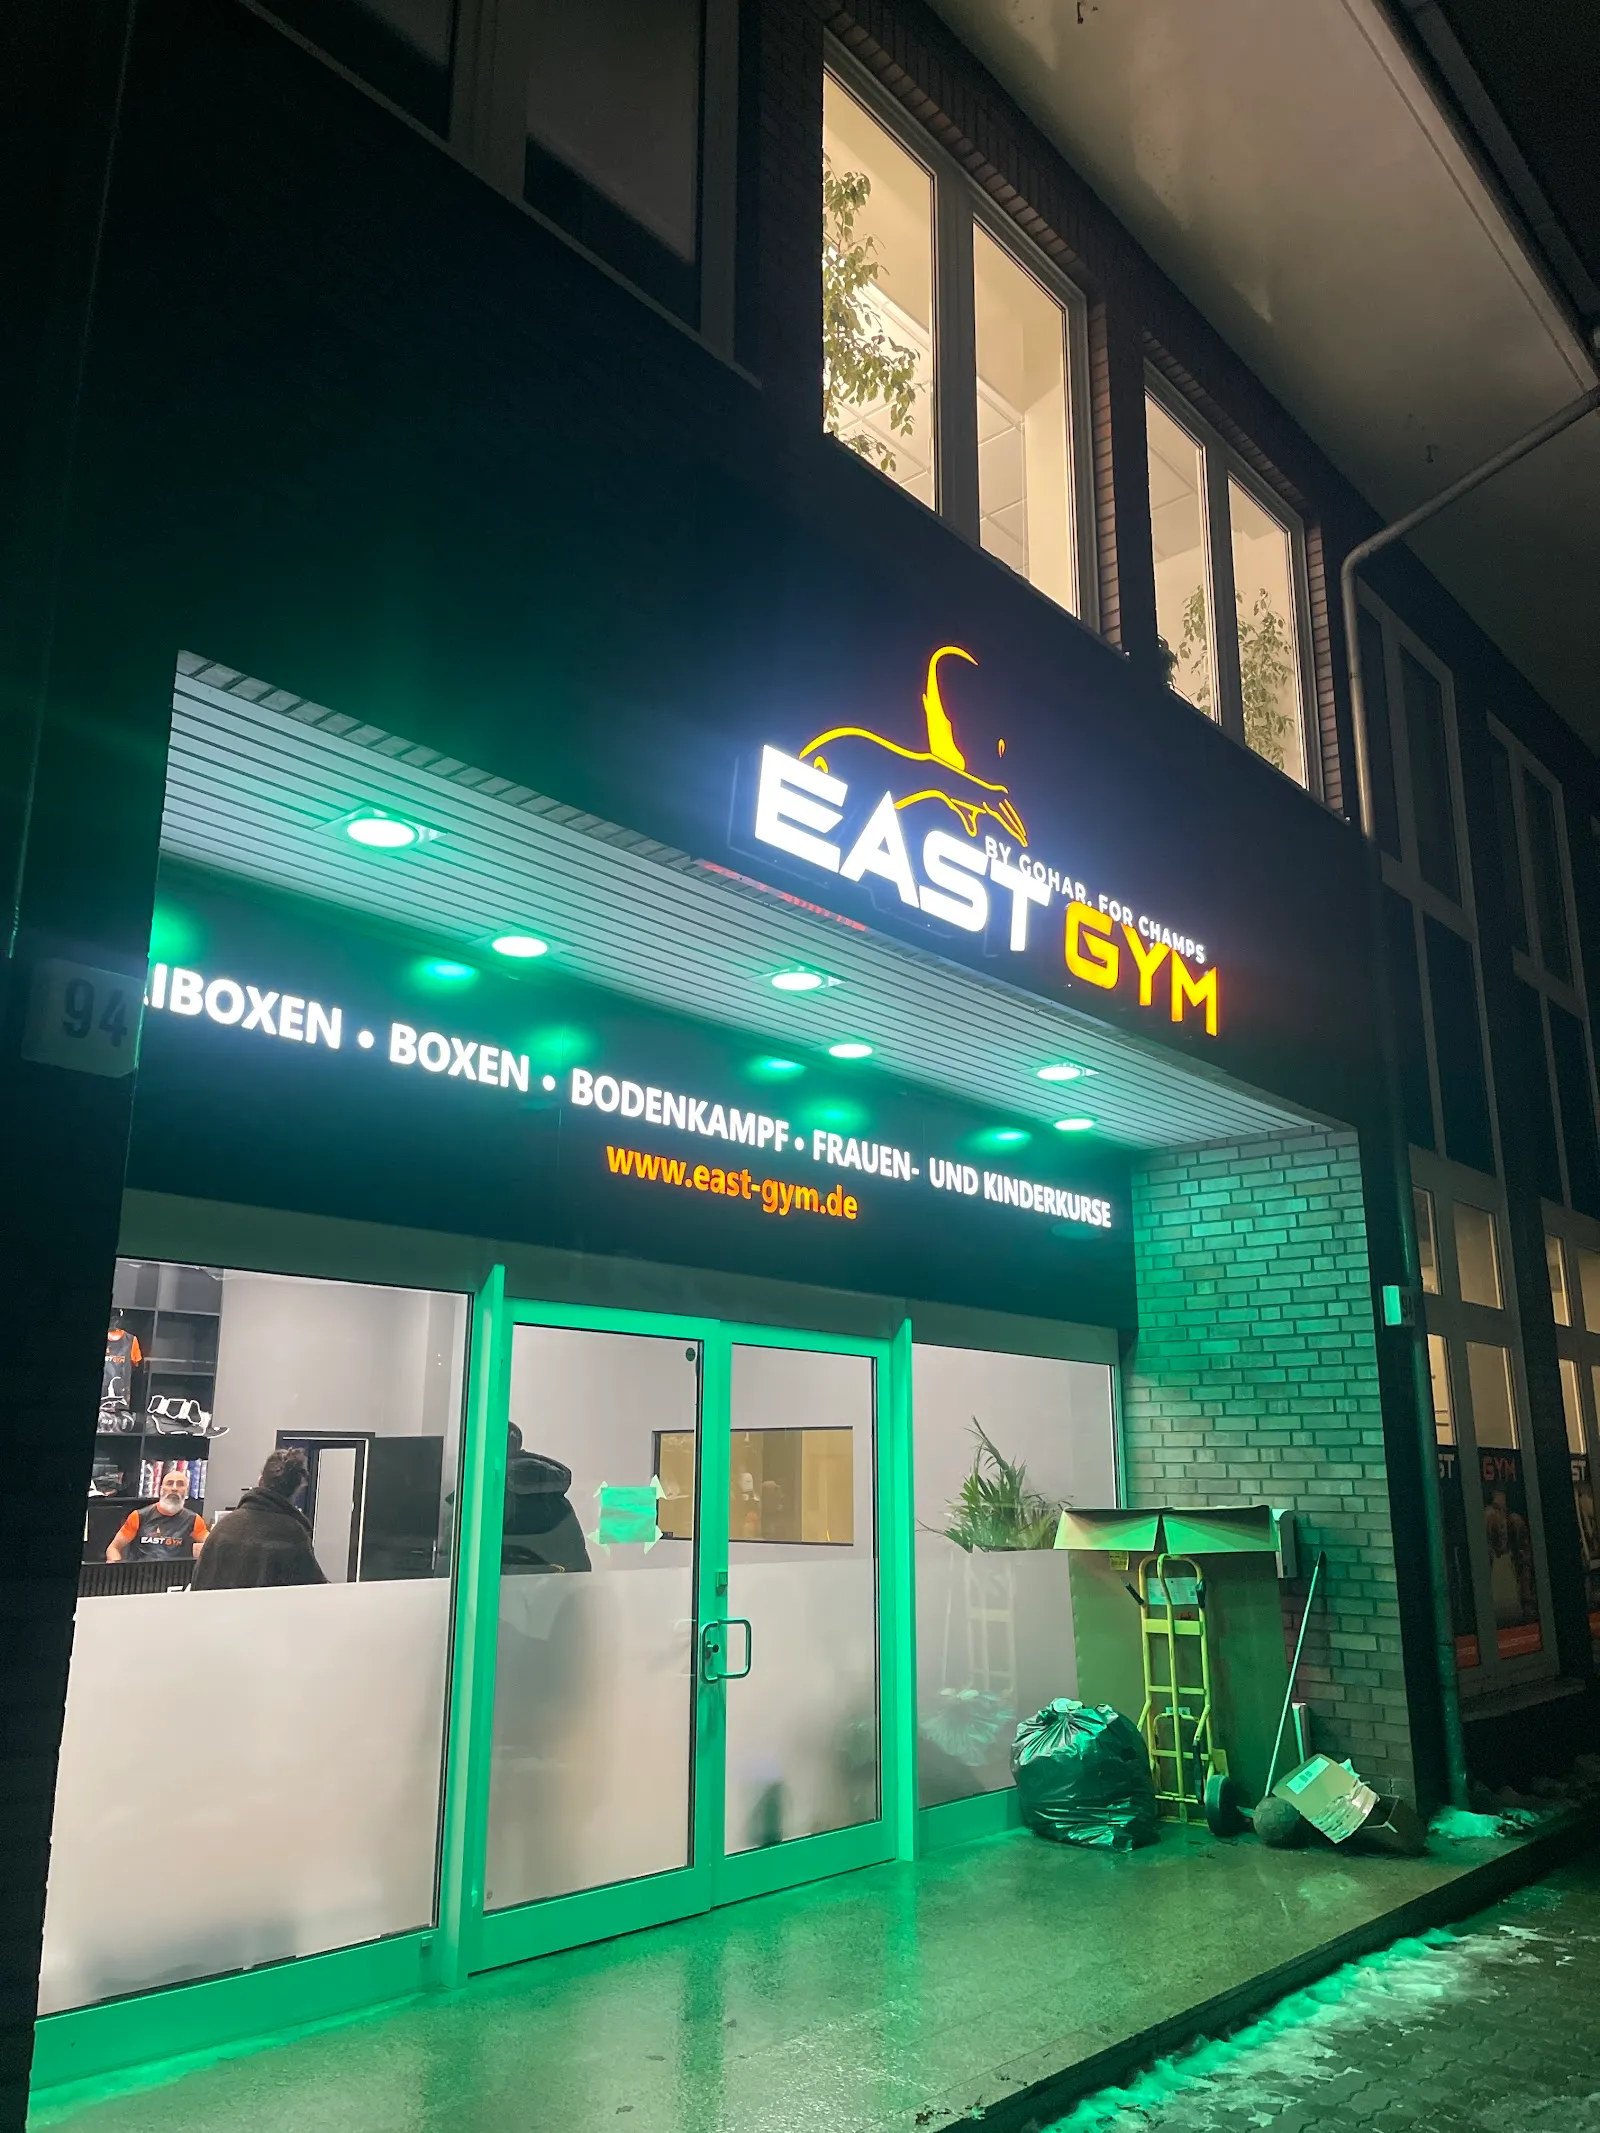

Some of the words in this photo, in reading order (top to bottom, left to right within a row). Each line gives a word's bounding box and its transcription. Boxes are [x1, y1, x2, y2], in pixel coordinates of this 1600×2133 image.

[754, 744, 1051, 952] EAST
[1064, 901, 1218, 1037] GYM
[985, 835, 1011, 866] BY
[1098, 894, 1134, 927] FOR
[1138, 915, 1206, 964] CHAMPS
[64, 978, 128, 1047] 94
[143, 962, 342, 1050] IBOXEN
[389, 1022, 530, 1093] BOXEN
[571, 1067, 790, 1152] BODENKAMPF
[812, 1128, 920, 1183] FRAUEN-
[928, 1156, 979, 1197] UND
[983, 1170, 1112, 1229] KINDERKURSE
[606, 1144, 859, 1220] www.east-gym.de
[1483, 1456, 1516, 1481] GYM
[1571, 1459, 1587, 1481] ST
[140, 1536, 165, 1545] EAST
